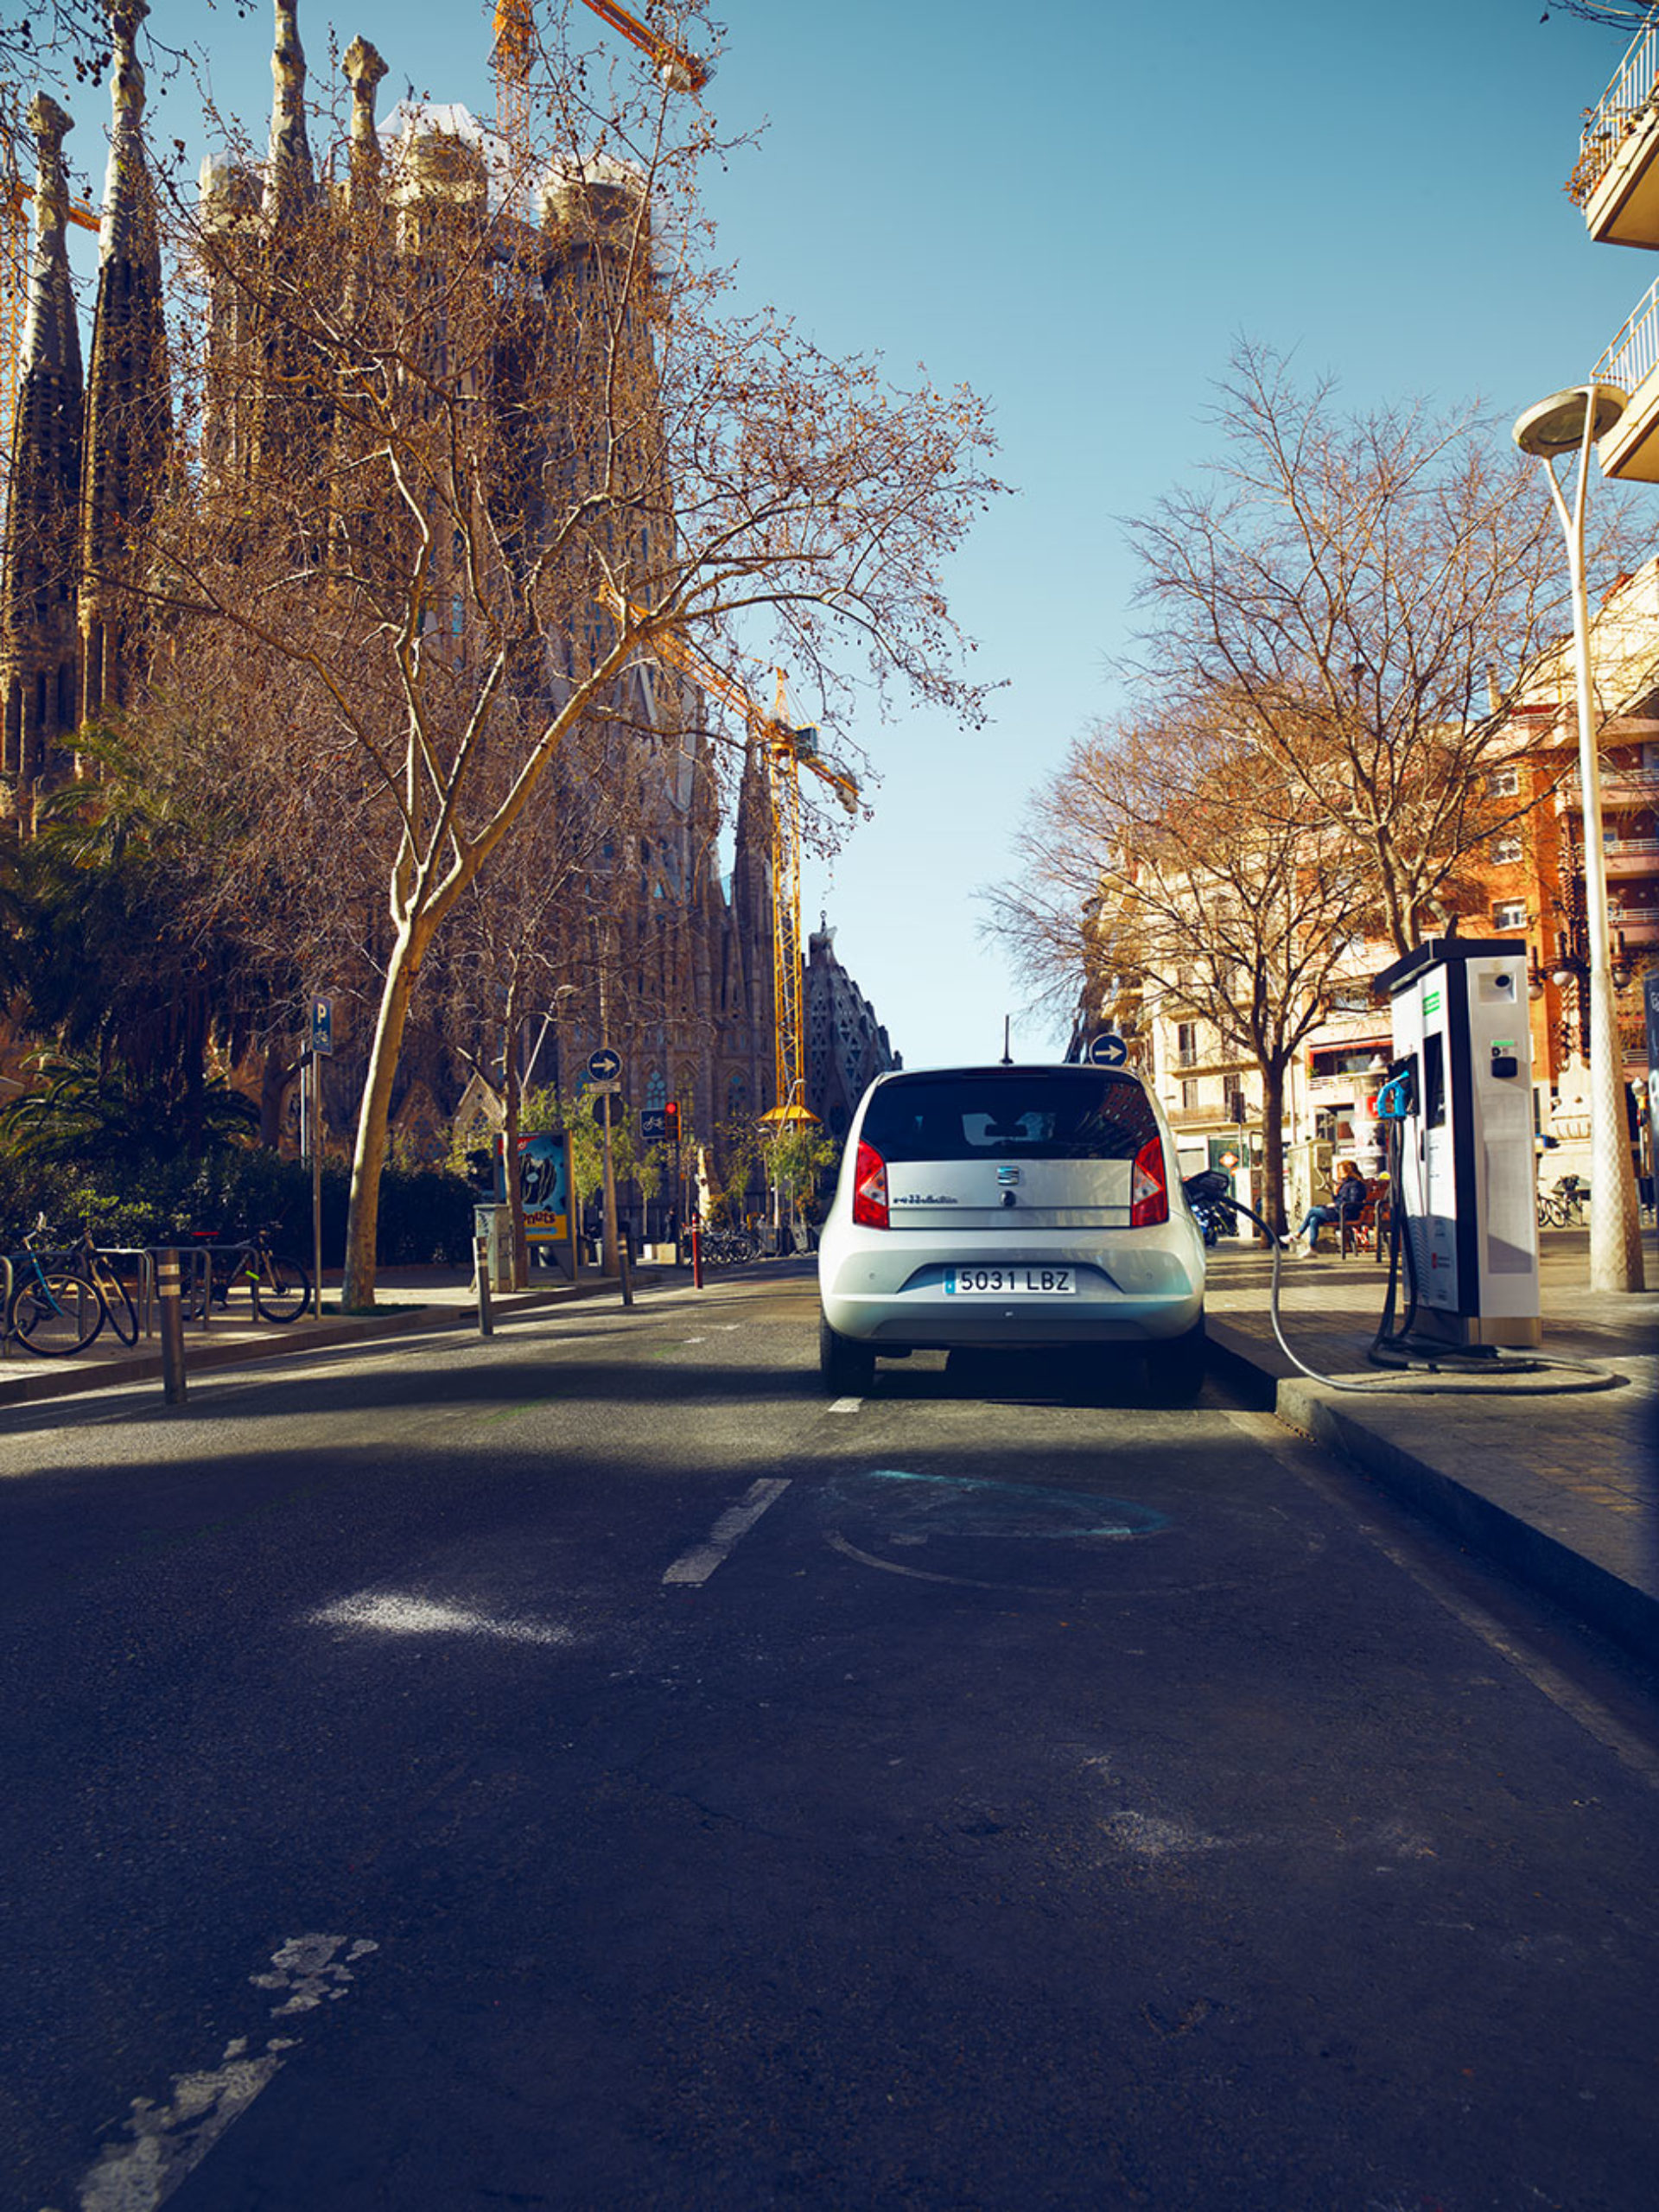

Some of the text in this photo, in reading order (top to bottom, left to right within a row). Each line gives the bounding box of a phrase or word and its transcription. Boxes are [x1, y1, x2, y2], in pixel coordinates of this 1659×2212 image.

[317, 1002, 327, 1024] P
[961, 1270, 1070, 1291] 5031 LBZ
